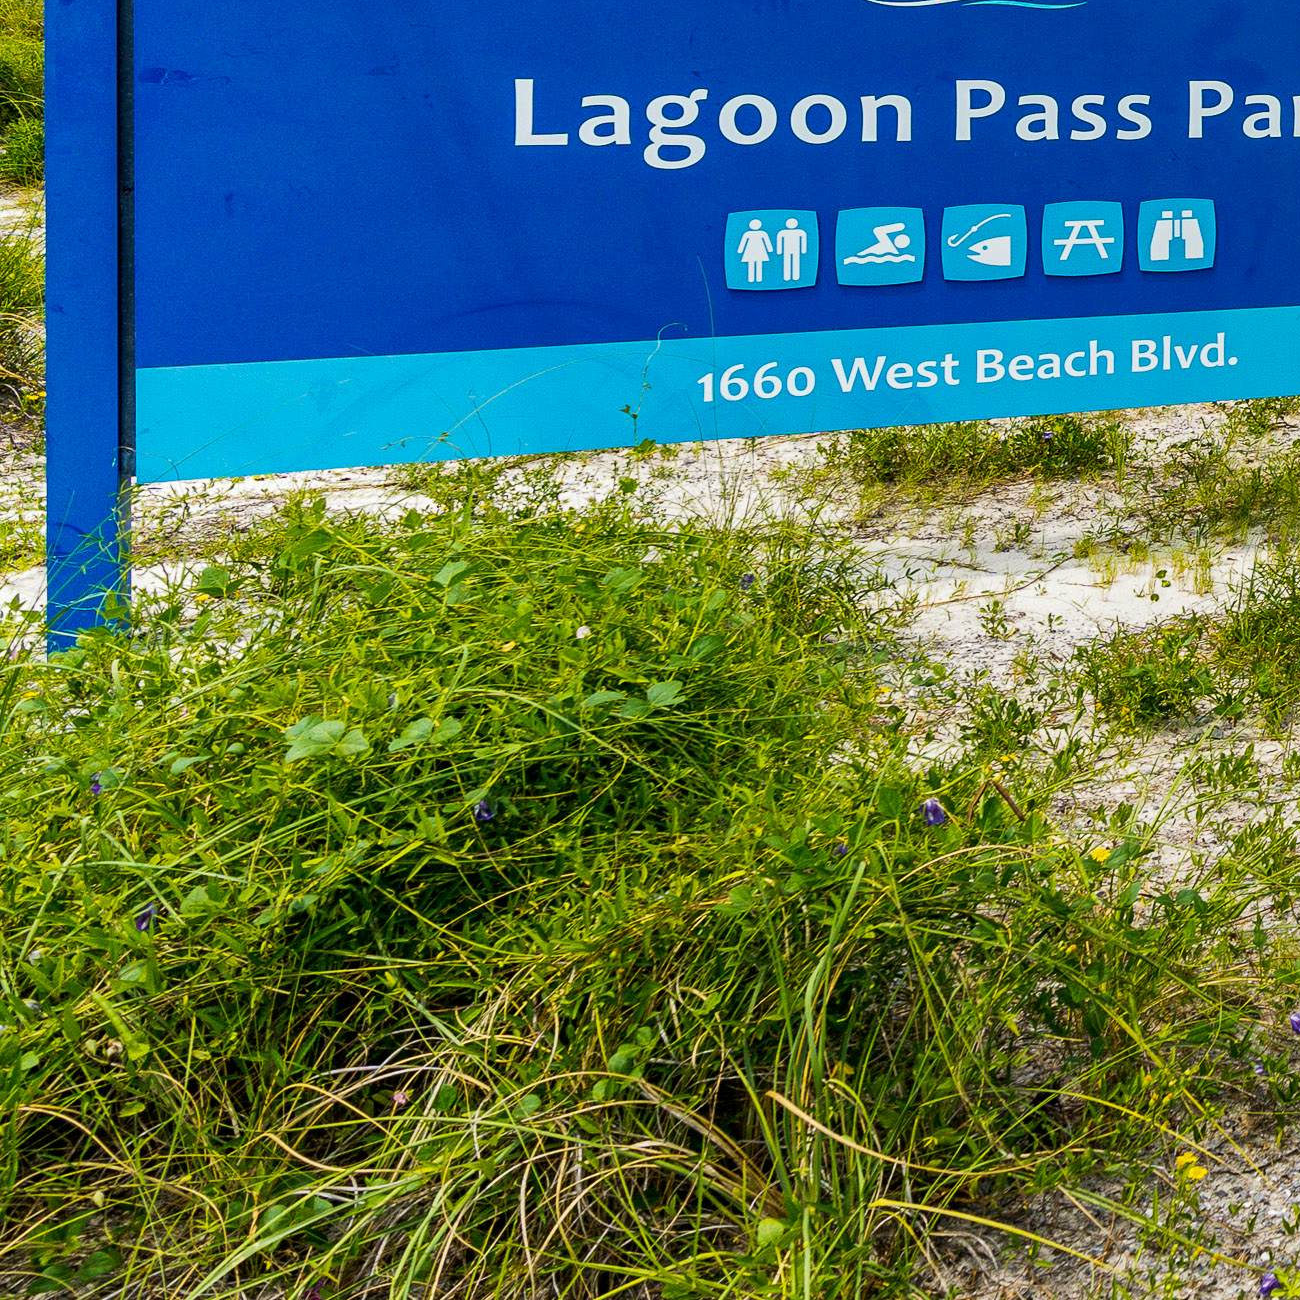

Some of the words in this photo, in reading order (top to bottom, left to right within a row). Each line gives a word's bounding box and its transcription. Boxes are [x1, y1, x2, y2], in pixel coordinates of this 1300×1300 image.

[513, 78, 913, 170] Lagoon
[954, 79, 1153, 141] Pass
[697, 361, 816, 403] 1660
[831, 353, 960, 393] West
[976, 339, 1115, 383] Beach
[1131, 332, 1239, 373] Blvd.
